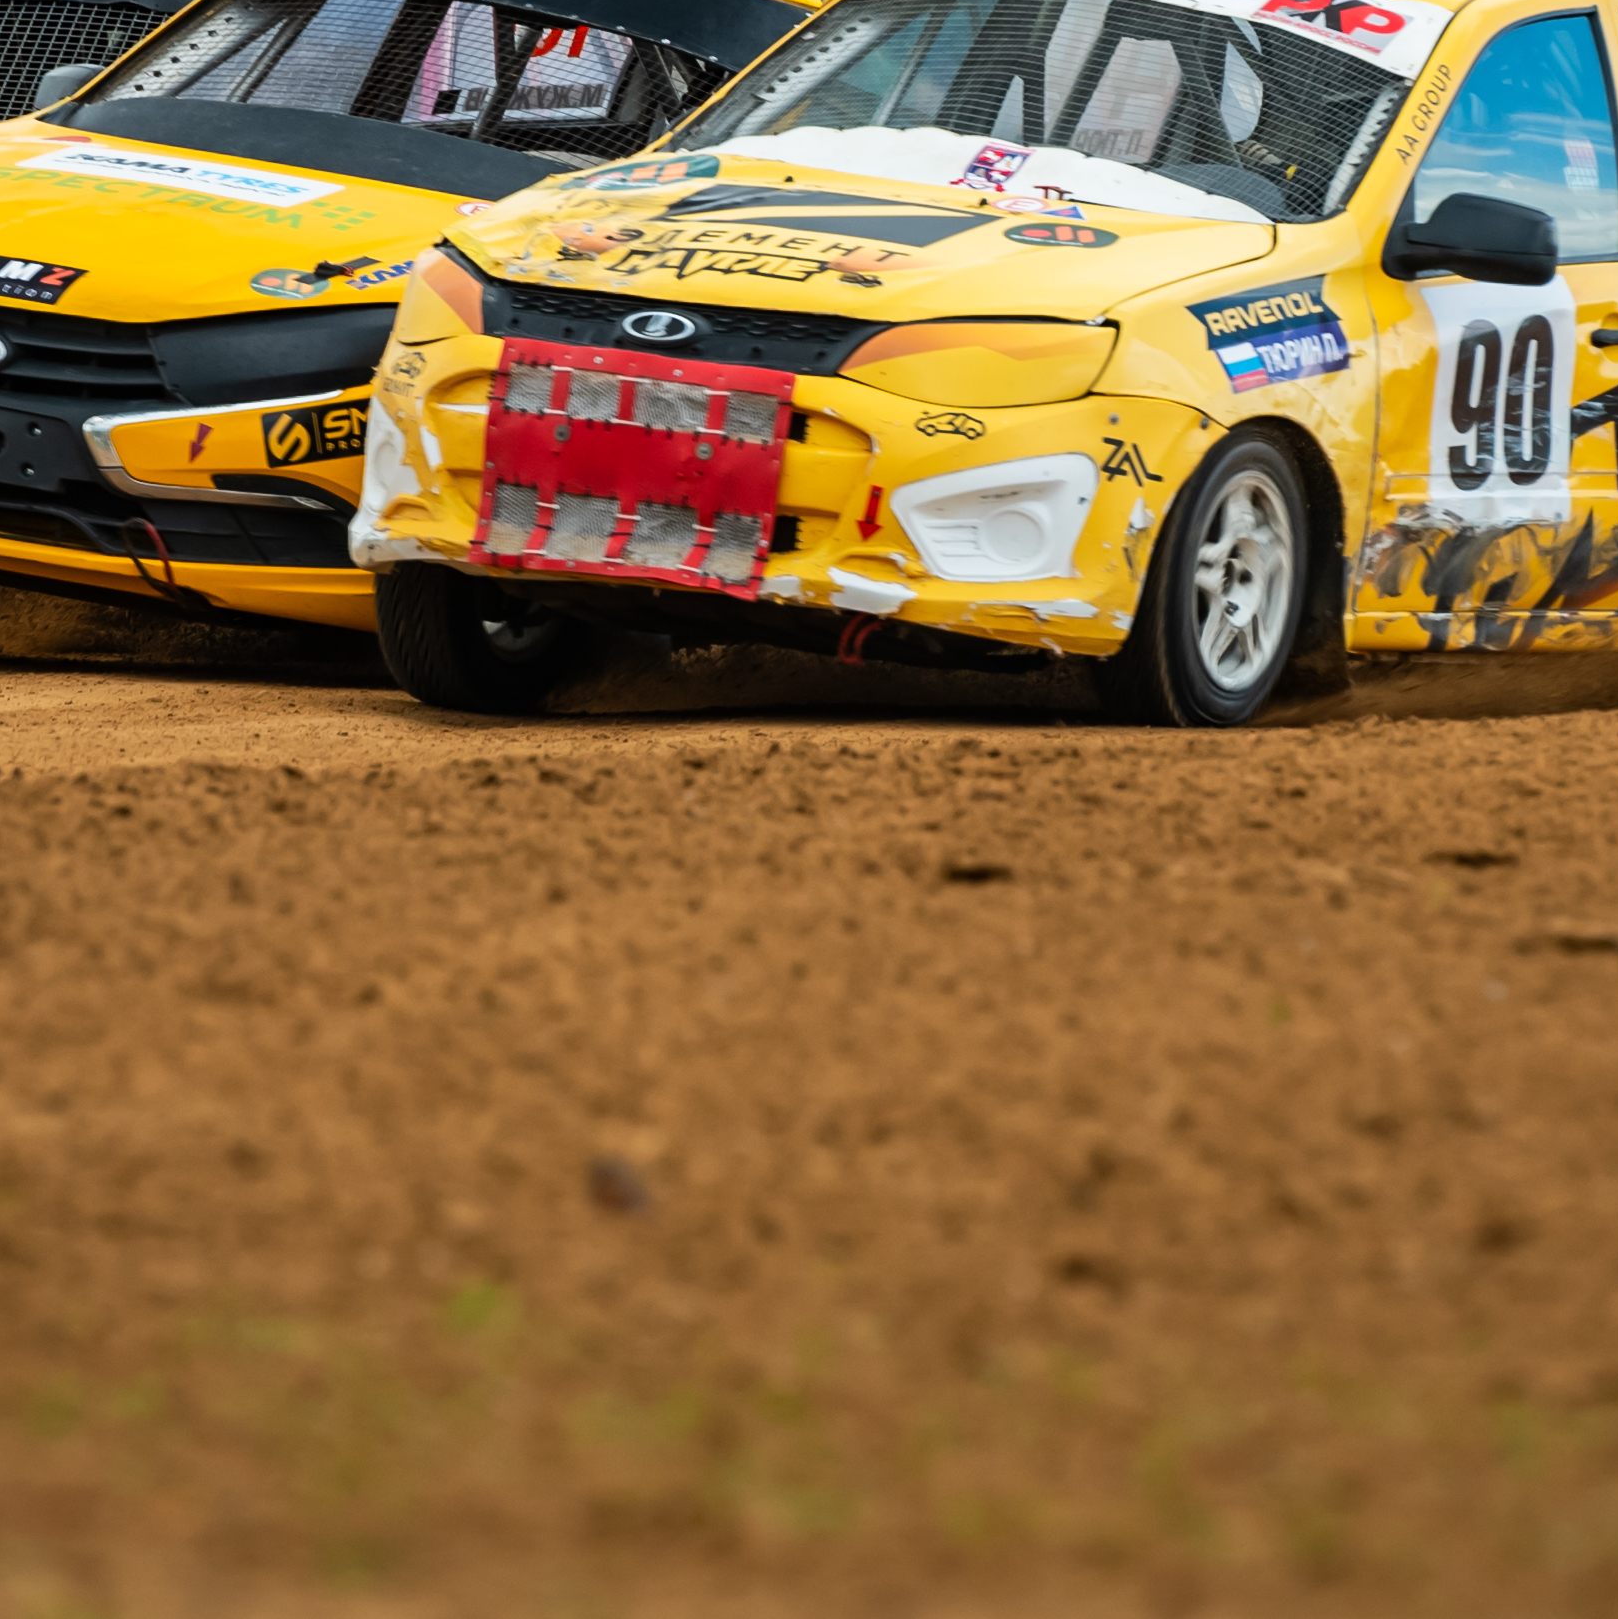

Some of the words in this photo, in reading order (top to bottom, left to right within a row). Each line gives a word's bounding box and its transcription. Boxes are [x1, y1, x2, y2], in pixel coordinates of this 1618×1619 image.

[1411, 64, 1453, 132] GROUP
[605, 228, 911, 262] ЭЛЕМЕНТ
[1204, 291, 1325, 337] RAVENOL
[1448, 314, 1555, 490] 90
